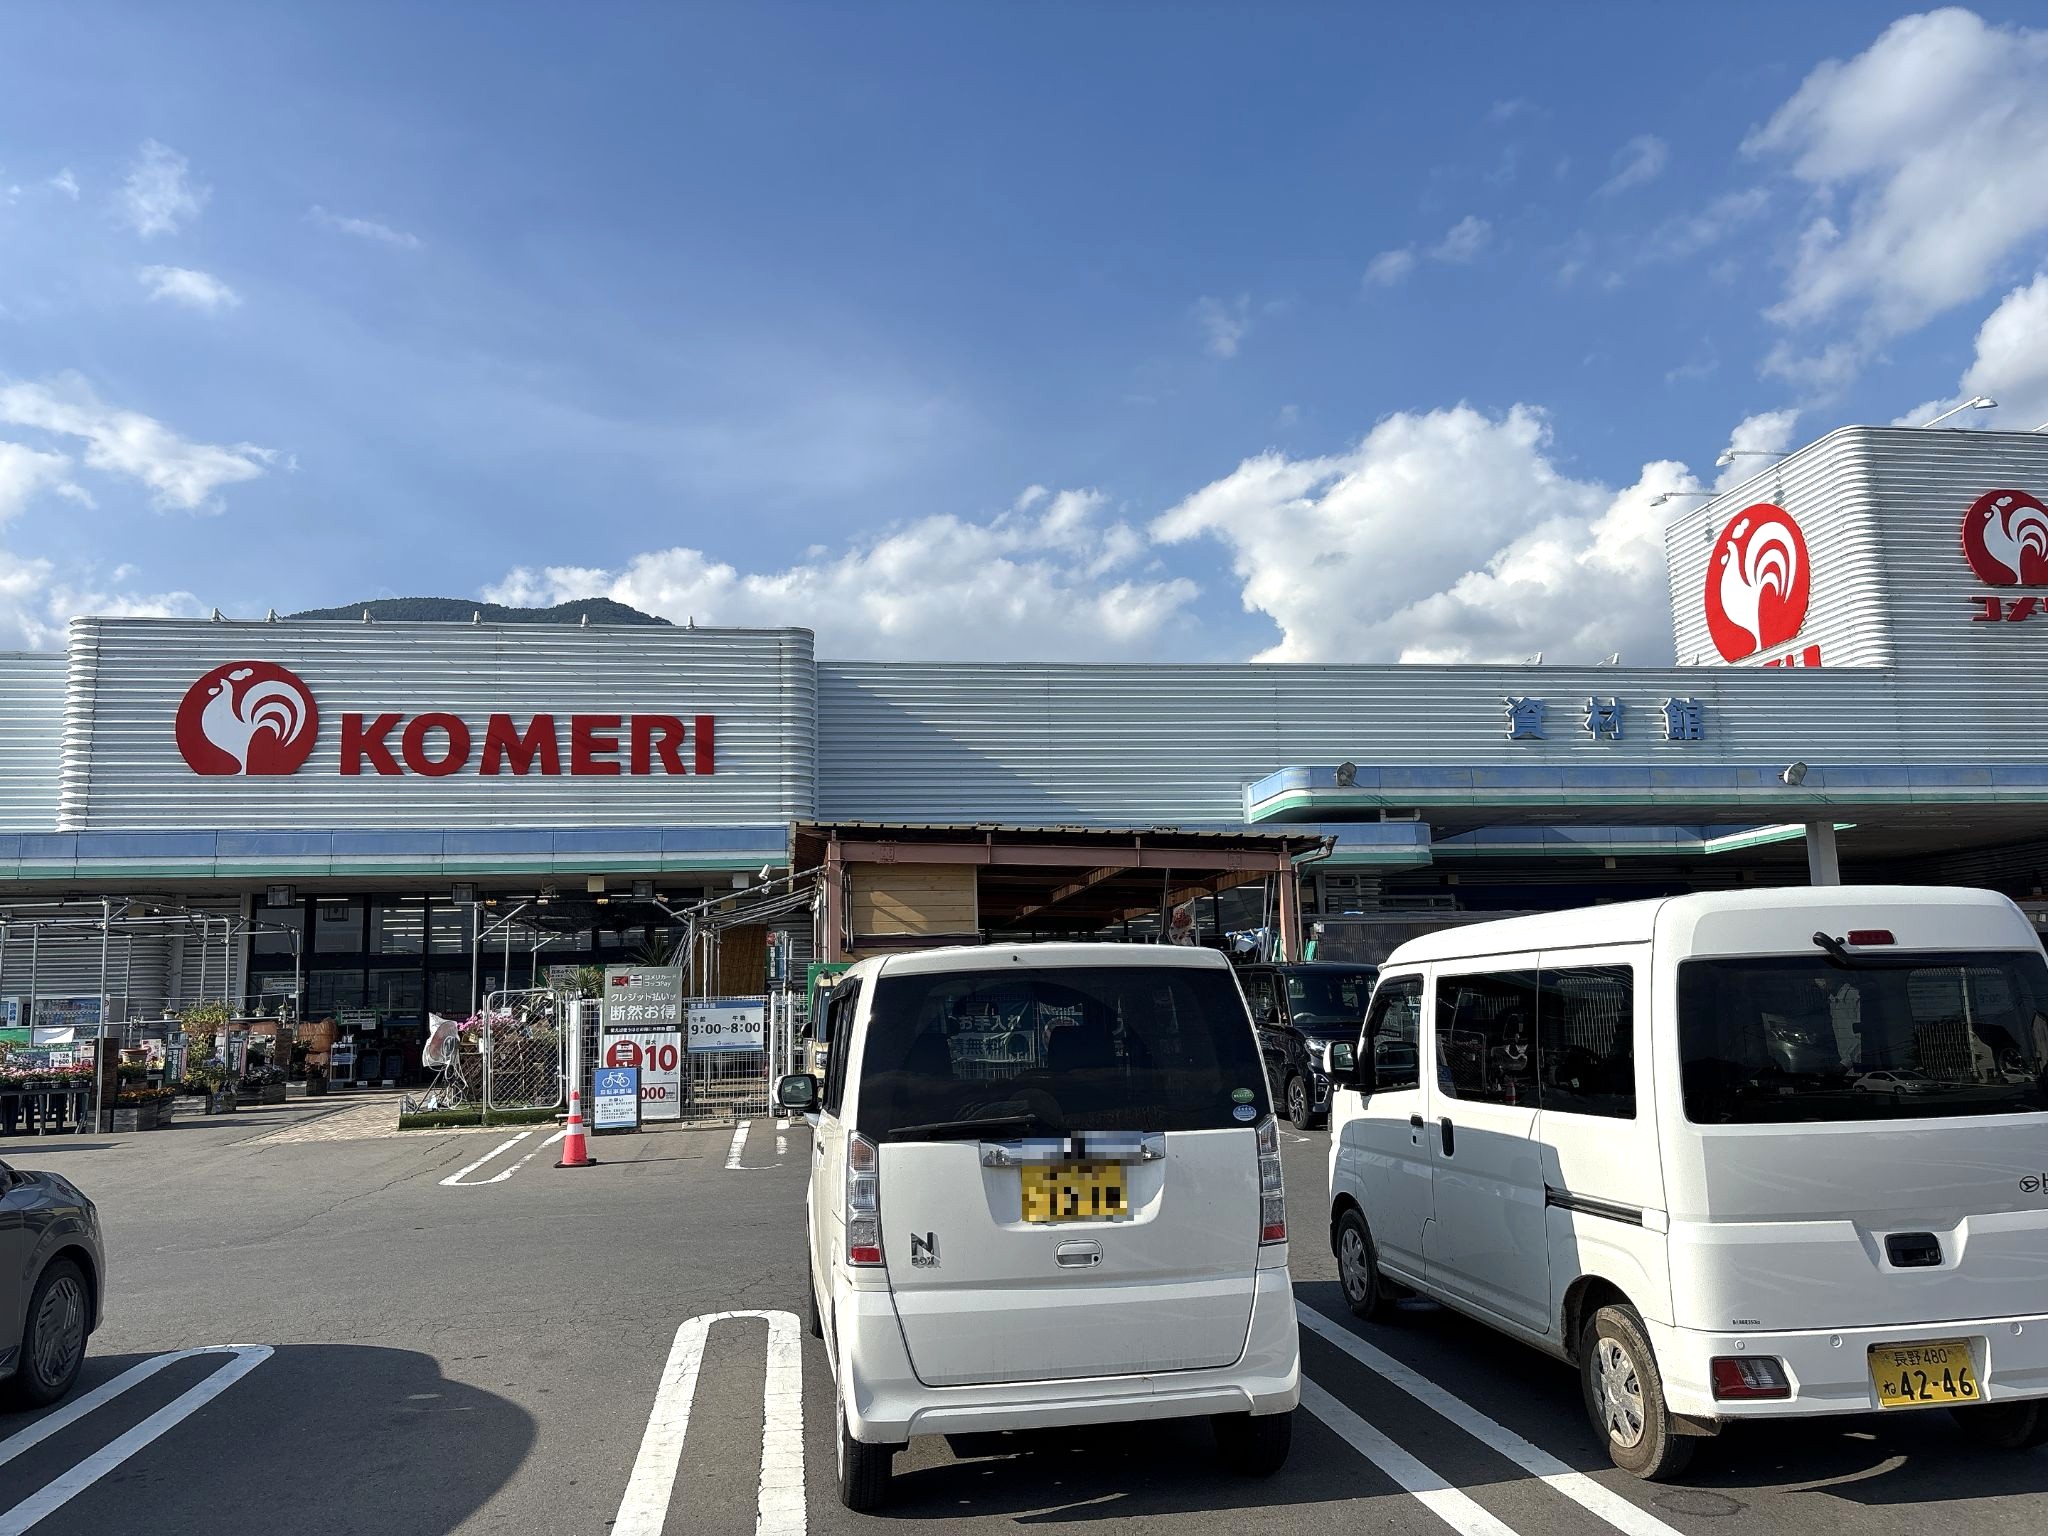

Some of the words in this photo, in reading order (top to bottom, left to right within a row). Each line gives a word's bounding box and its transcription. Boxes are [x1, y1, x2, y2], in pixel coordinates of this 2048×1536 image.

[1969, 596, 2048, 621] コメ
[1505, 696, 1705, 740] 資材館
[340, 712, 715, 777] KOMERI
[610, 1004, 677, 1020] 断然お得
[645, 1044, 678, 1071] 10
[1901, 1367, 1974, 1401] 42-46
